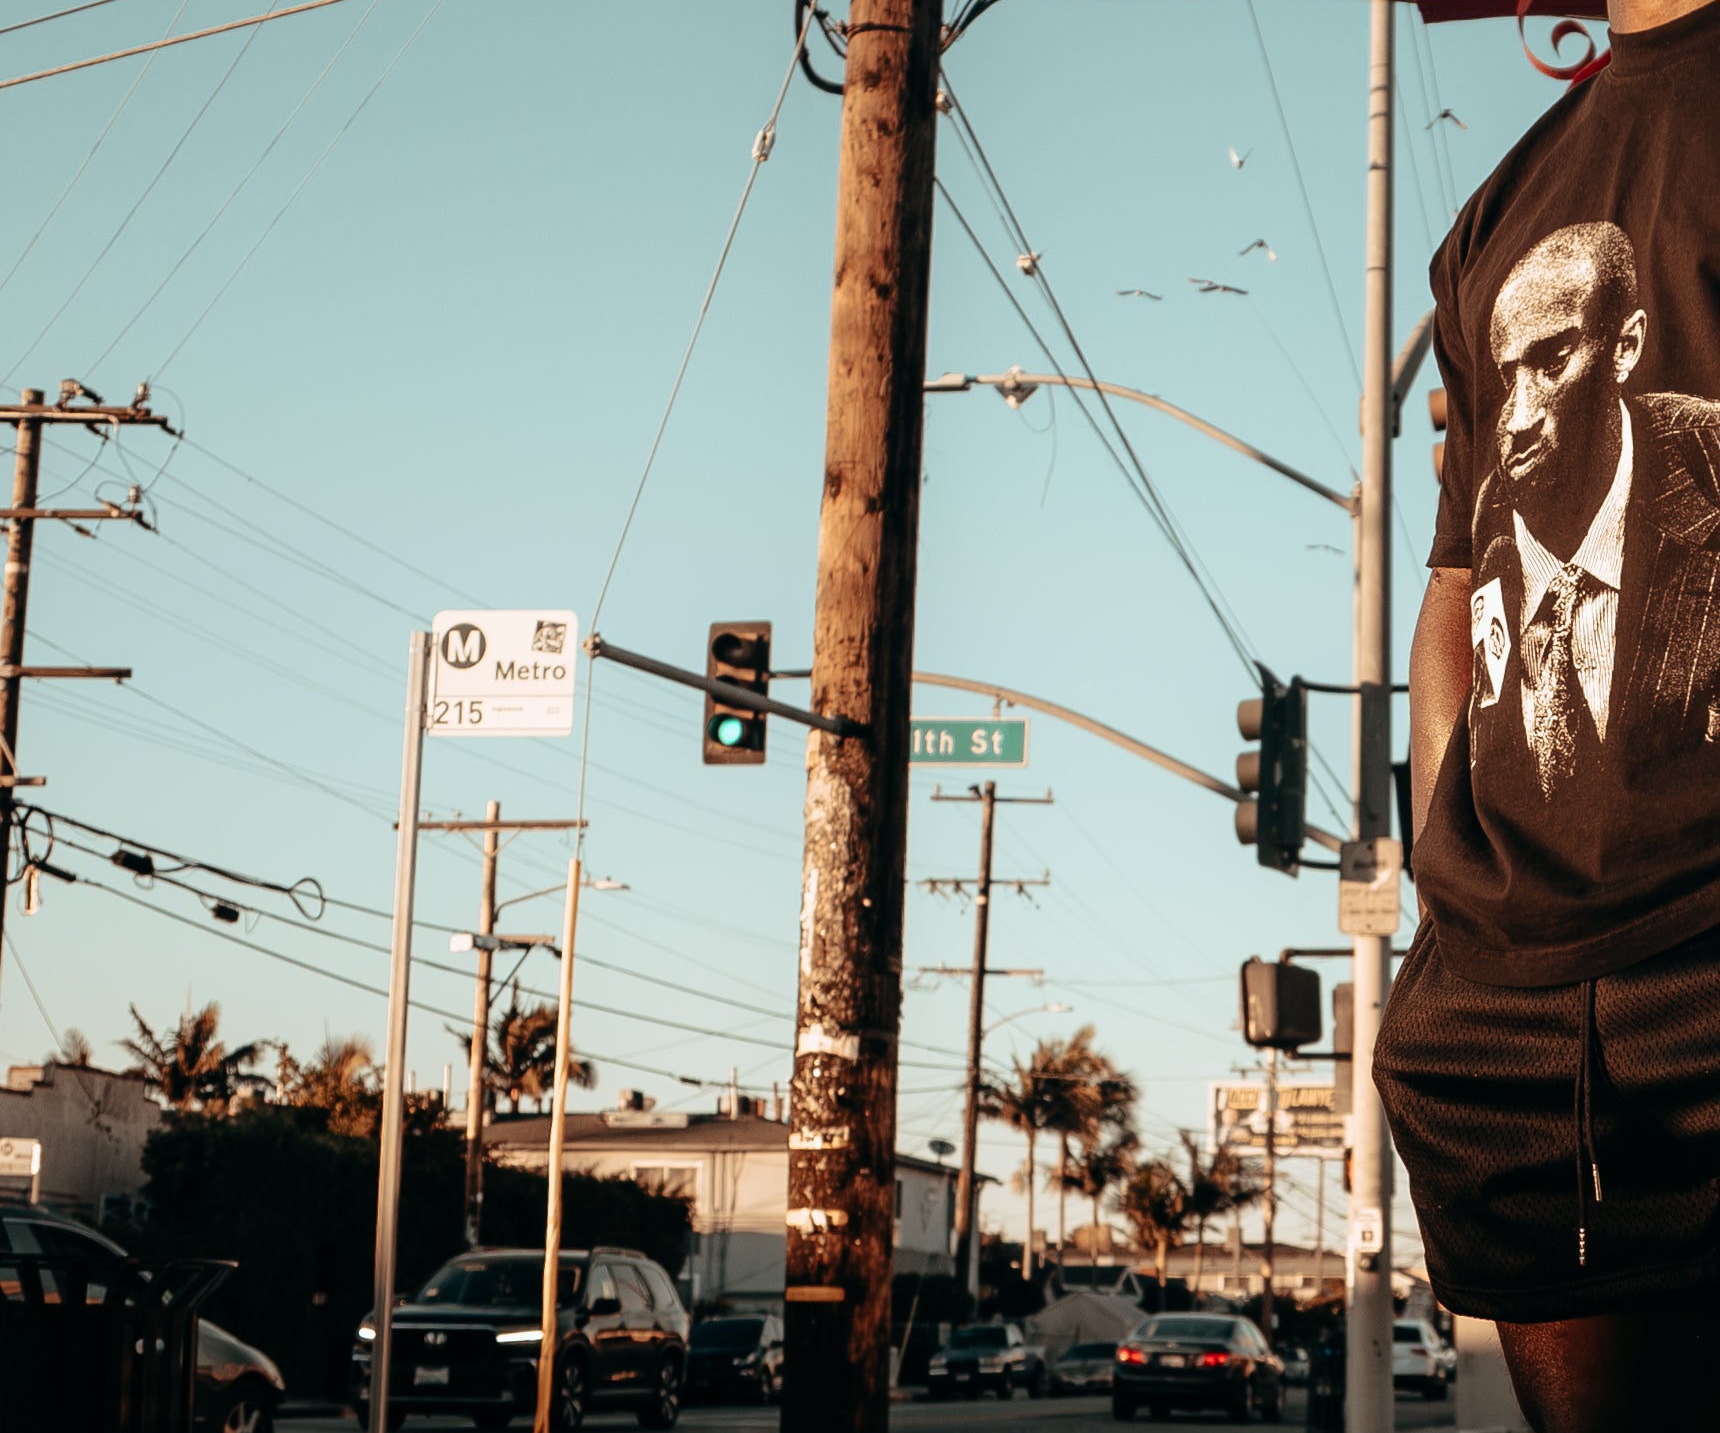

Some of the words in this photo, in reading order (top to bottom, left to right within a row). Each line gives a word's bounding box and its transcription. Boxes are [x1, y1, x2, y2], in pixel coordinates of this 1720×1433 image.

[495, 661, 567, 680] Metro
[434, 700, 483, 725] 215
[970, 729, 1003, 755] St
